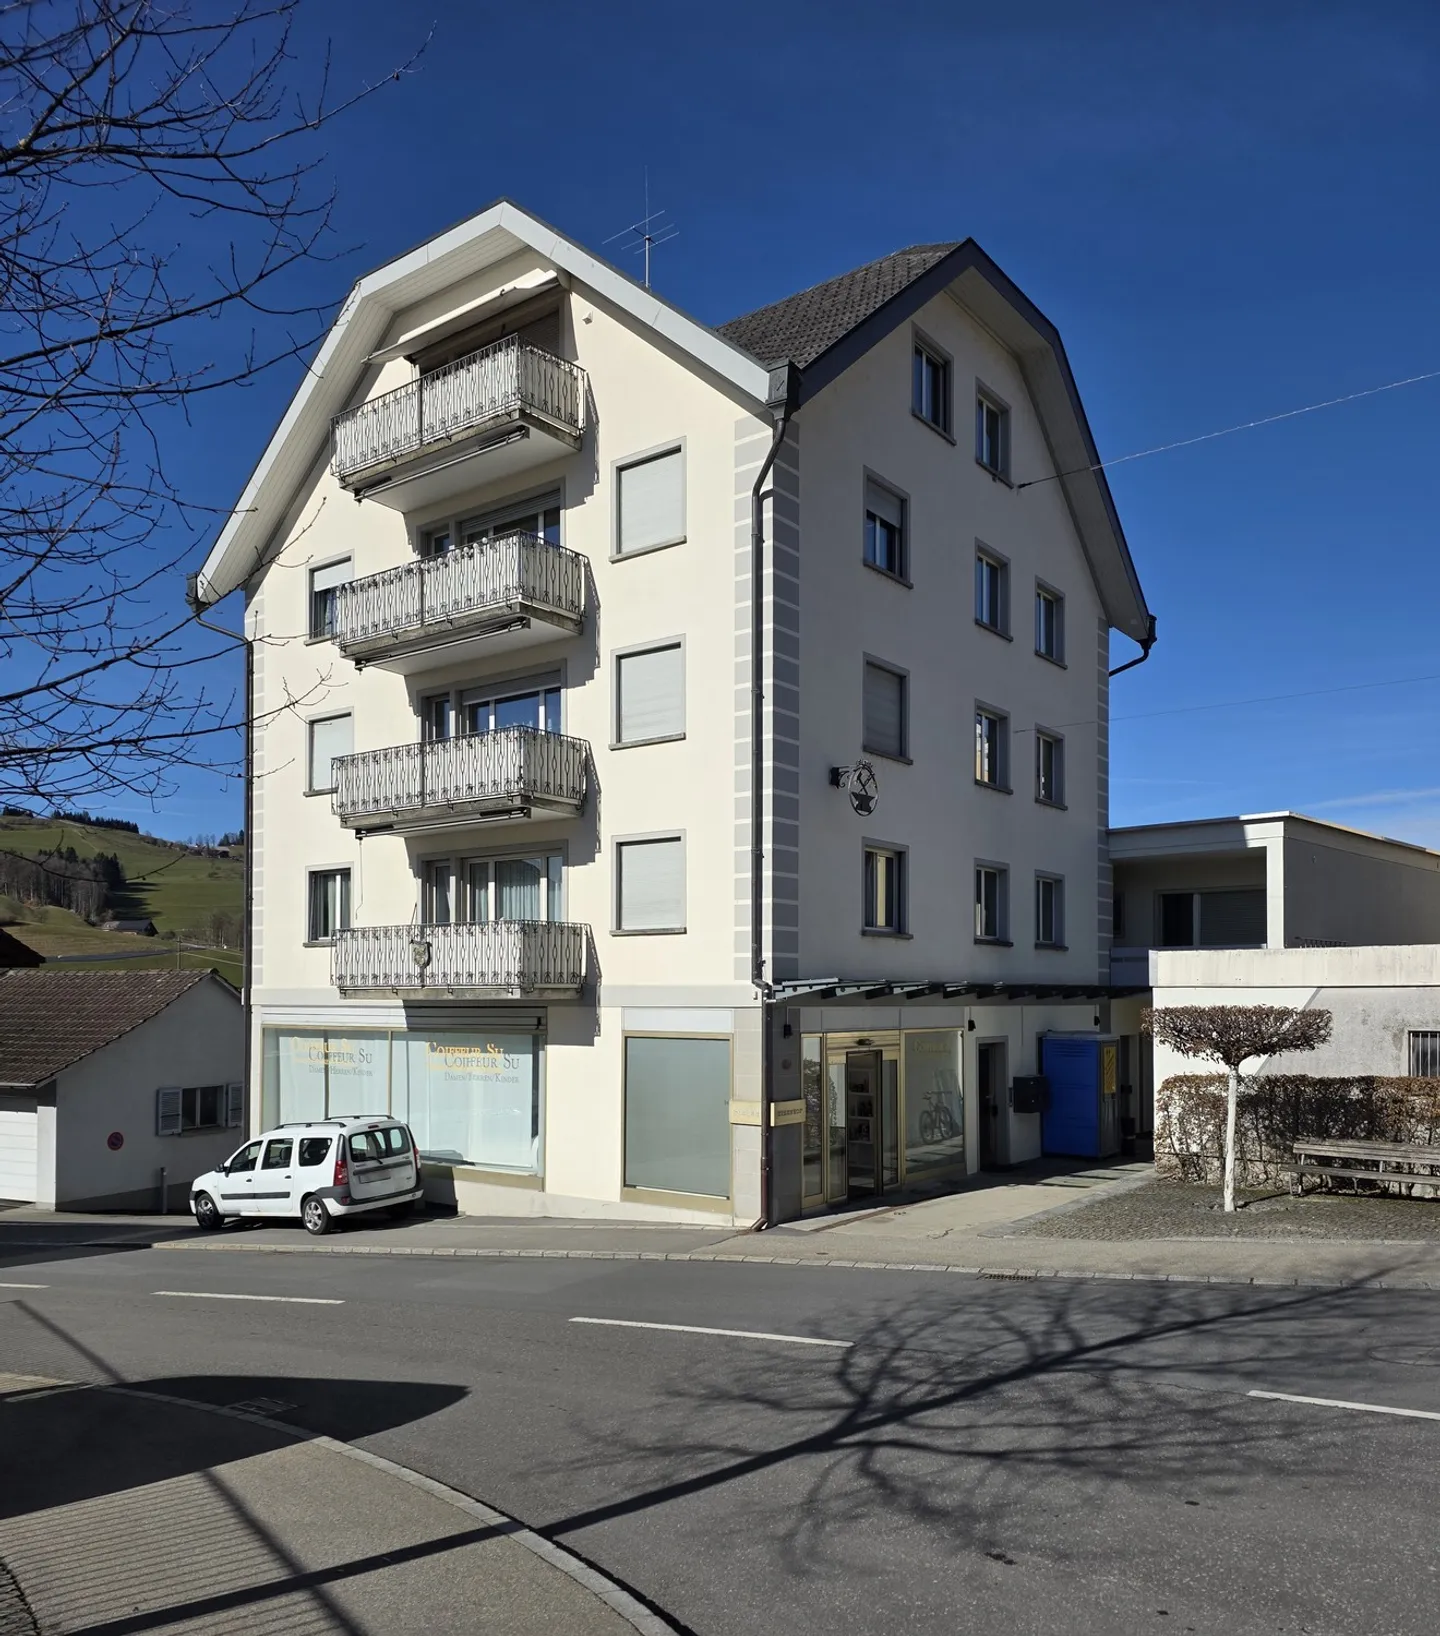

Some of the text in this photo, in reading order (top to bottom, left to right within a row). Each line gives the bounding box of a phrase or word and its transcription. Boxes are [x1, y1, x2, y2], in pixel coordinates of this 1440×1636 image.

[308, 1046, 373, 1064] COFFEUR SU
[503, 1053, 520, 1070] SU
